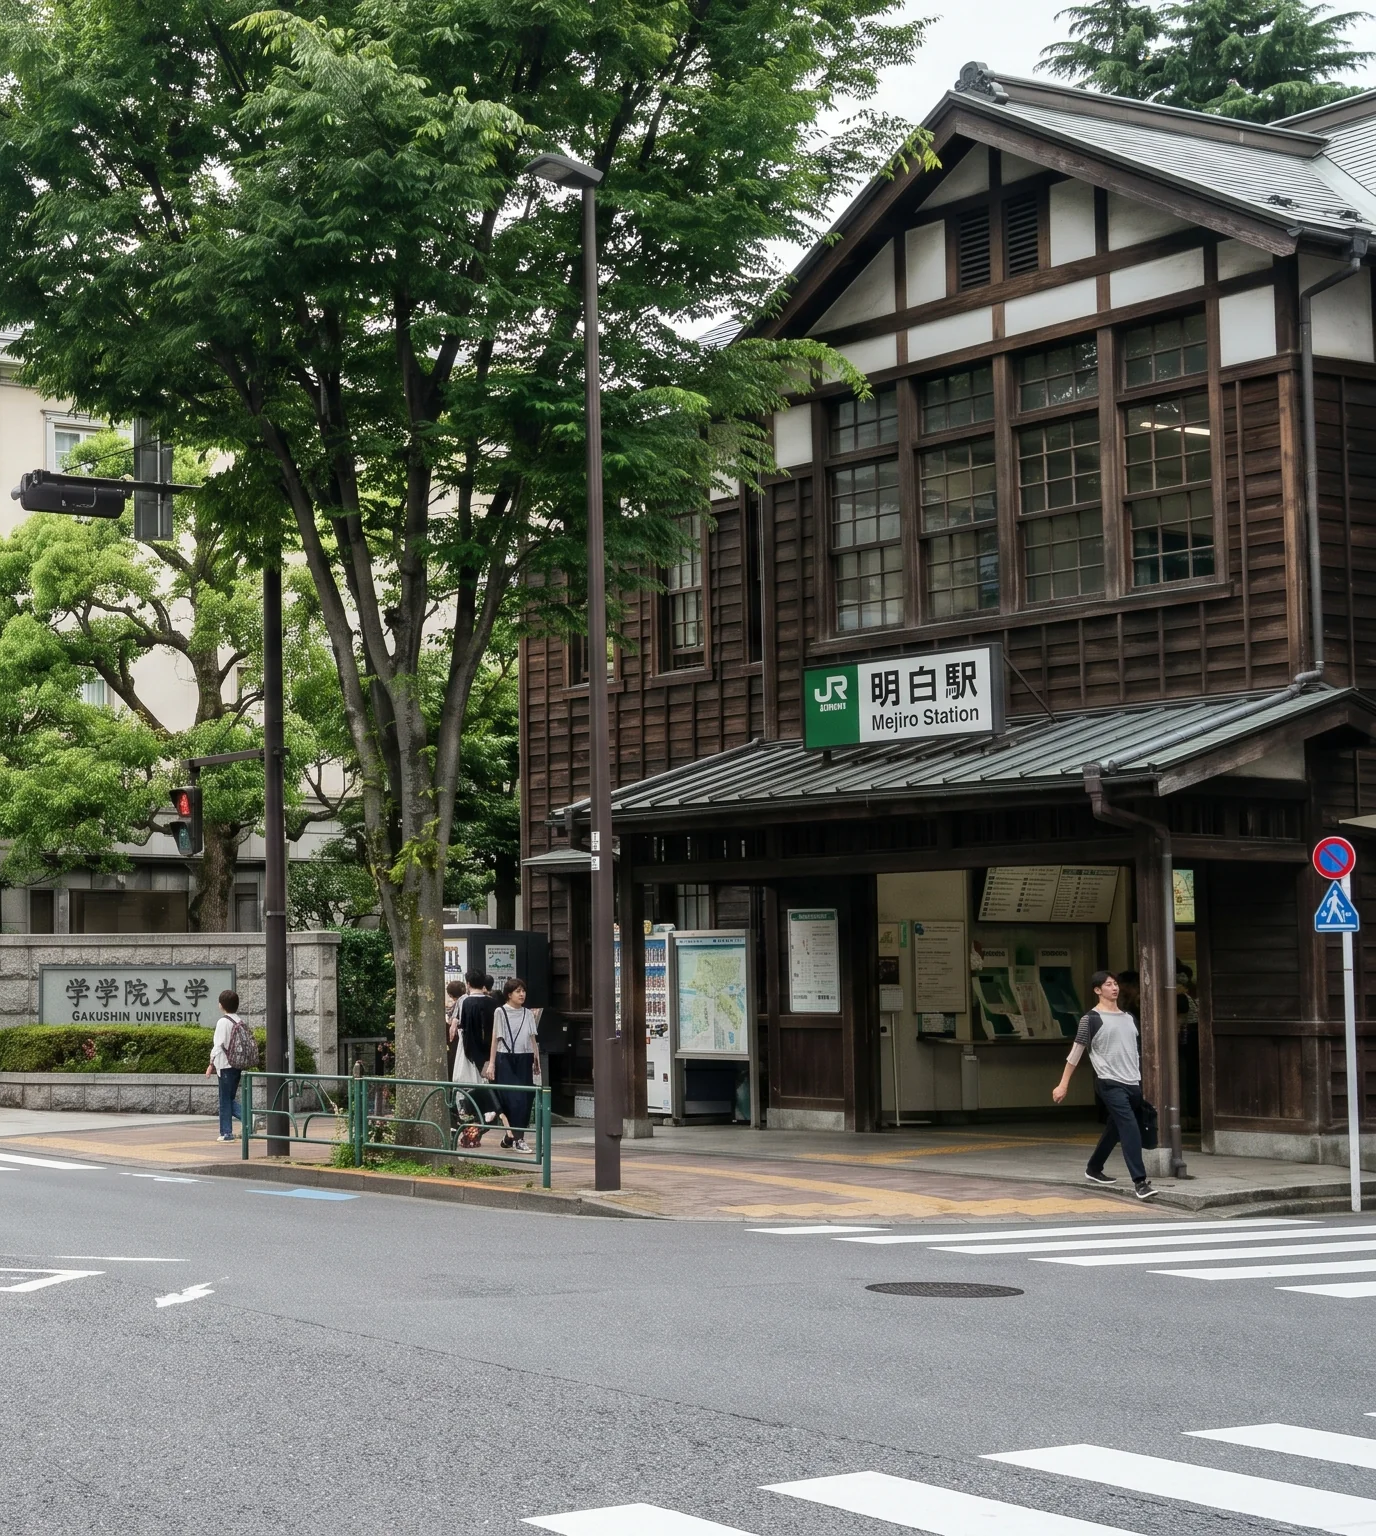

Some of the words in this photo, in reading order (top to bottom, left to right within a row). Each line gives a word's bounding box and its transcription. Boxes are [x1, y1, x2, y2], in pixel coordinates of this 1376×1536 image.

[814, 675, 847, 702] JR
[870, 660, 978, 707] 明白駅
[872, 712, 918, 733] Mejiro
[924, 706, 979, 725] Station
[65, 977, 210, 1008] 学学院大学
[72, 1010, 130, 1022] GAKUSHIN
[136, 1011, 202, 1022] UNIVERSITY
